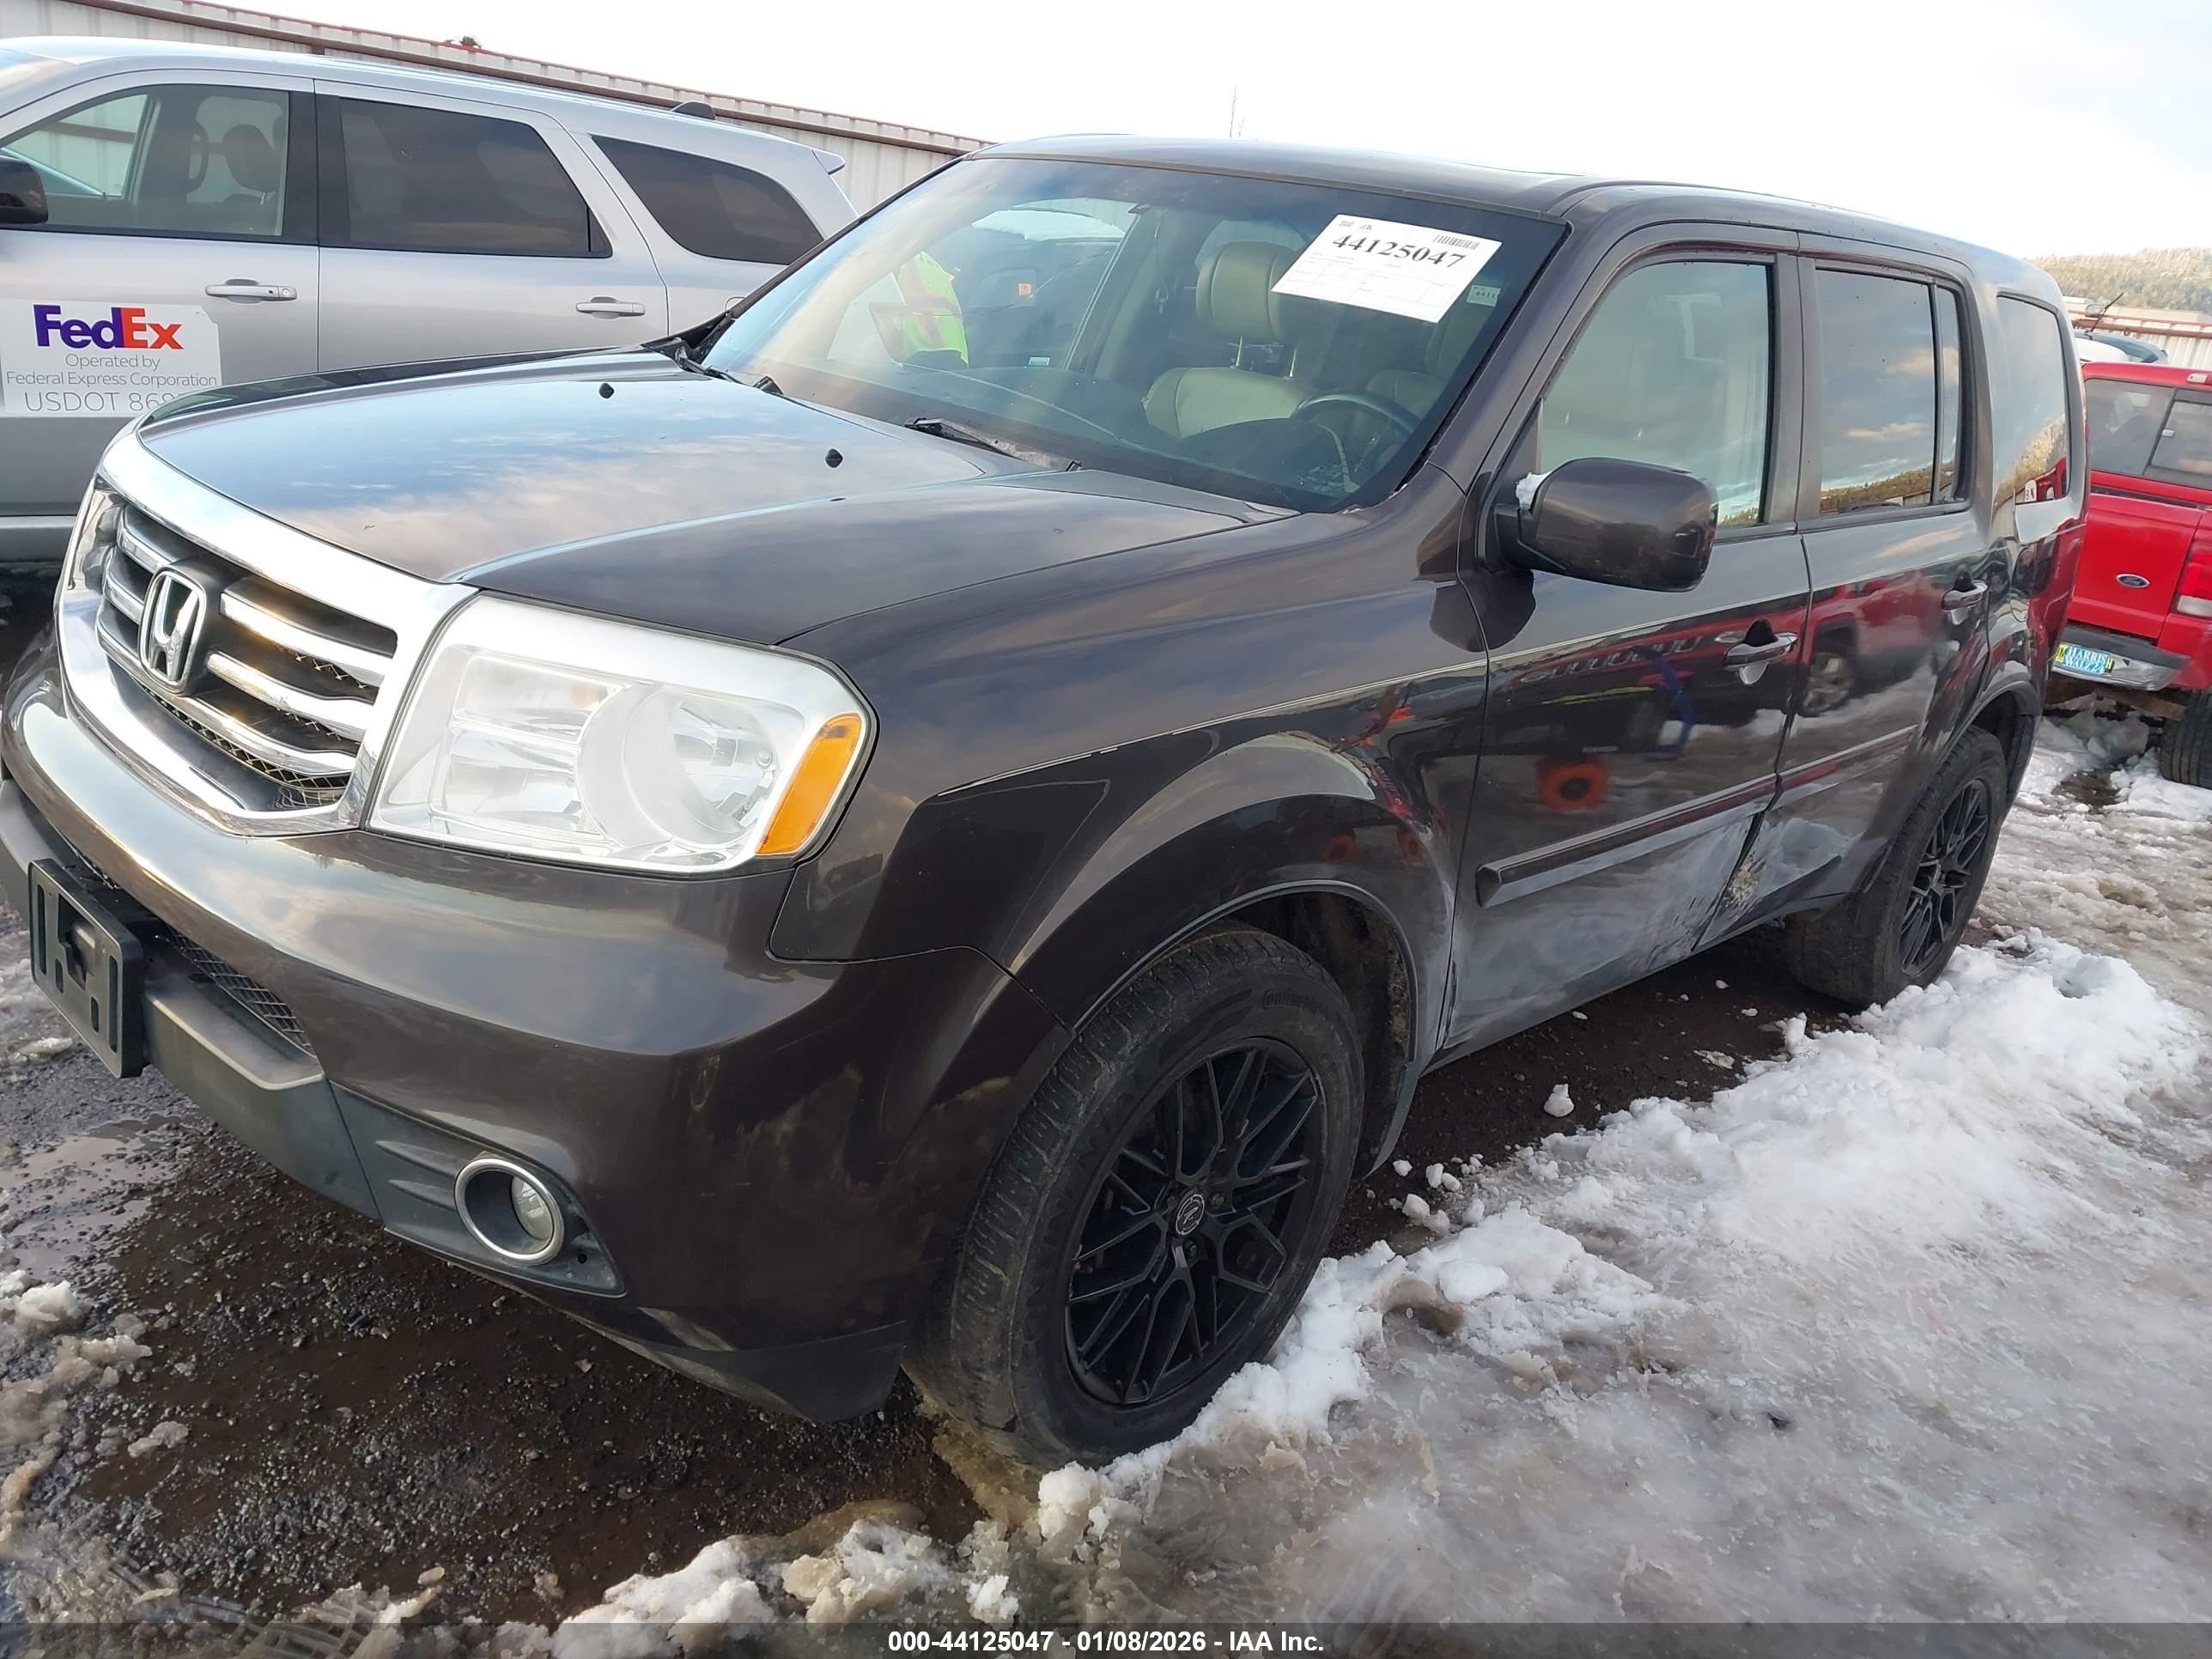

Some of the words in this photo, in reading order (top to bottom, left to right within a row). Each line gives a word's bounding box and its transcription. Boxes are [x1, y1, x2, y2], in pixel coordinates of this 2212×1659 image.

[1332, 234, 1467, 268] 44125047
[33, 304, 185, 350] FedEx
[65, 353, 138, 370] Operated
[142, 354, 161, 372] by
[6, 371, 64, 385] Federal
[68, 371, 127, 388] Express
[130, 372, 217, 389] Corporation
[24, 392, 119, 411] USDOT
[2065, 645, 2110, 665] HARRIS
